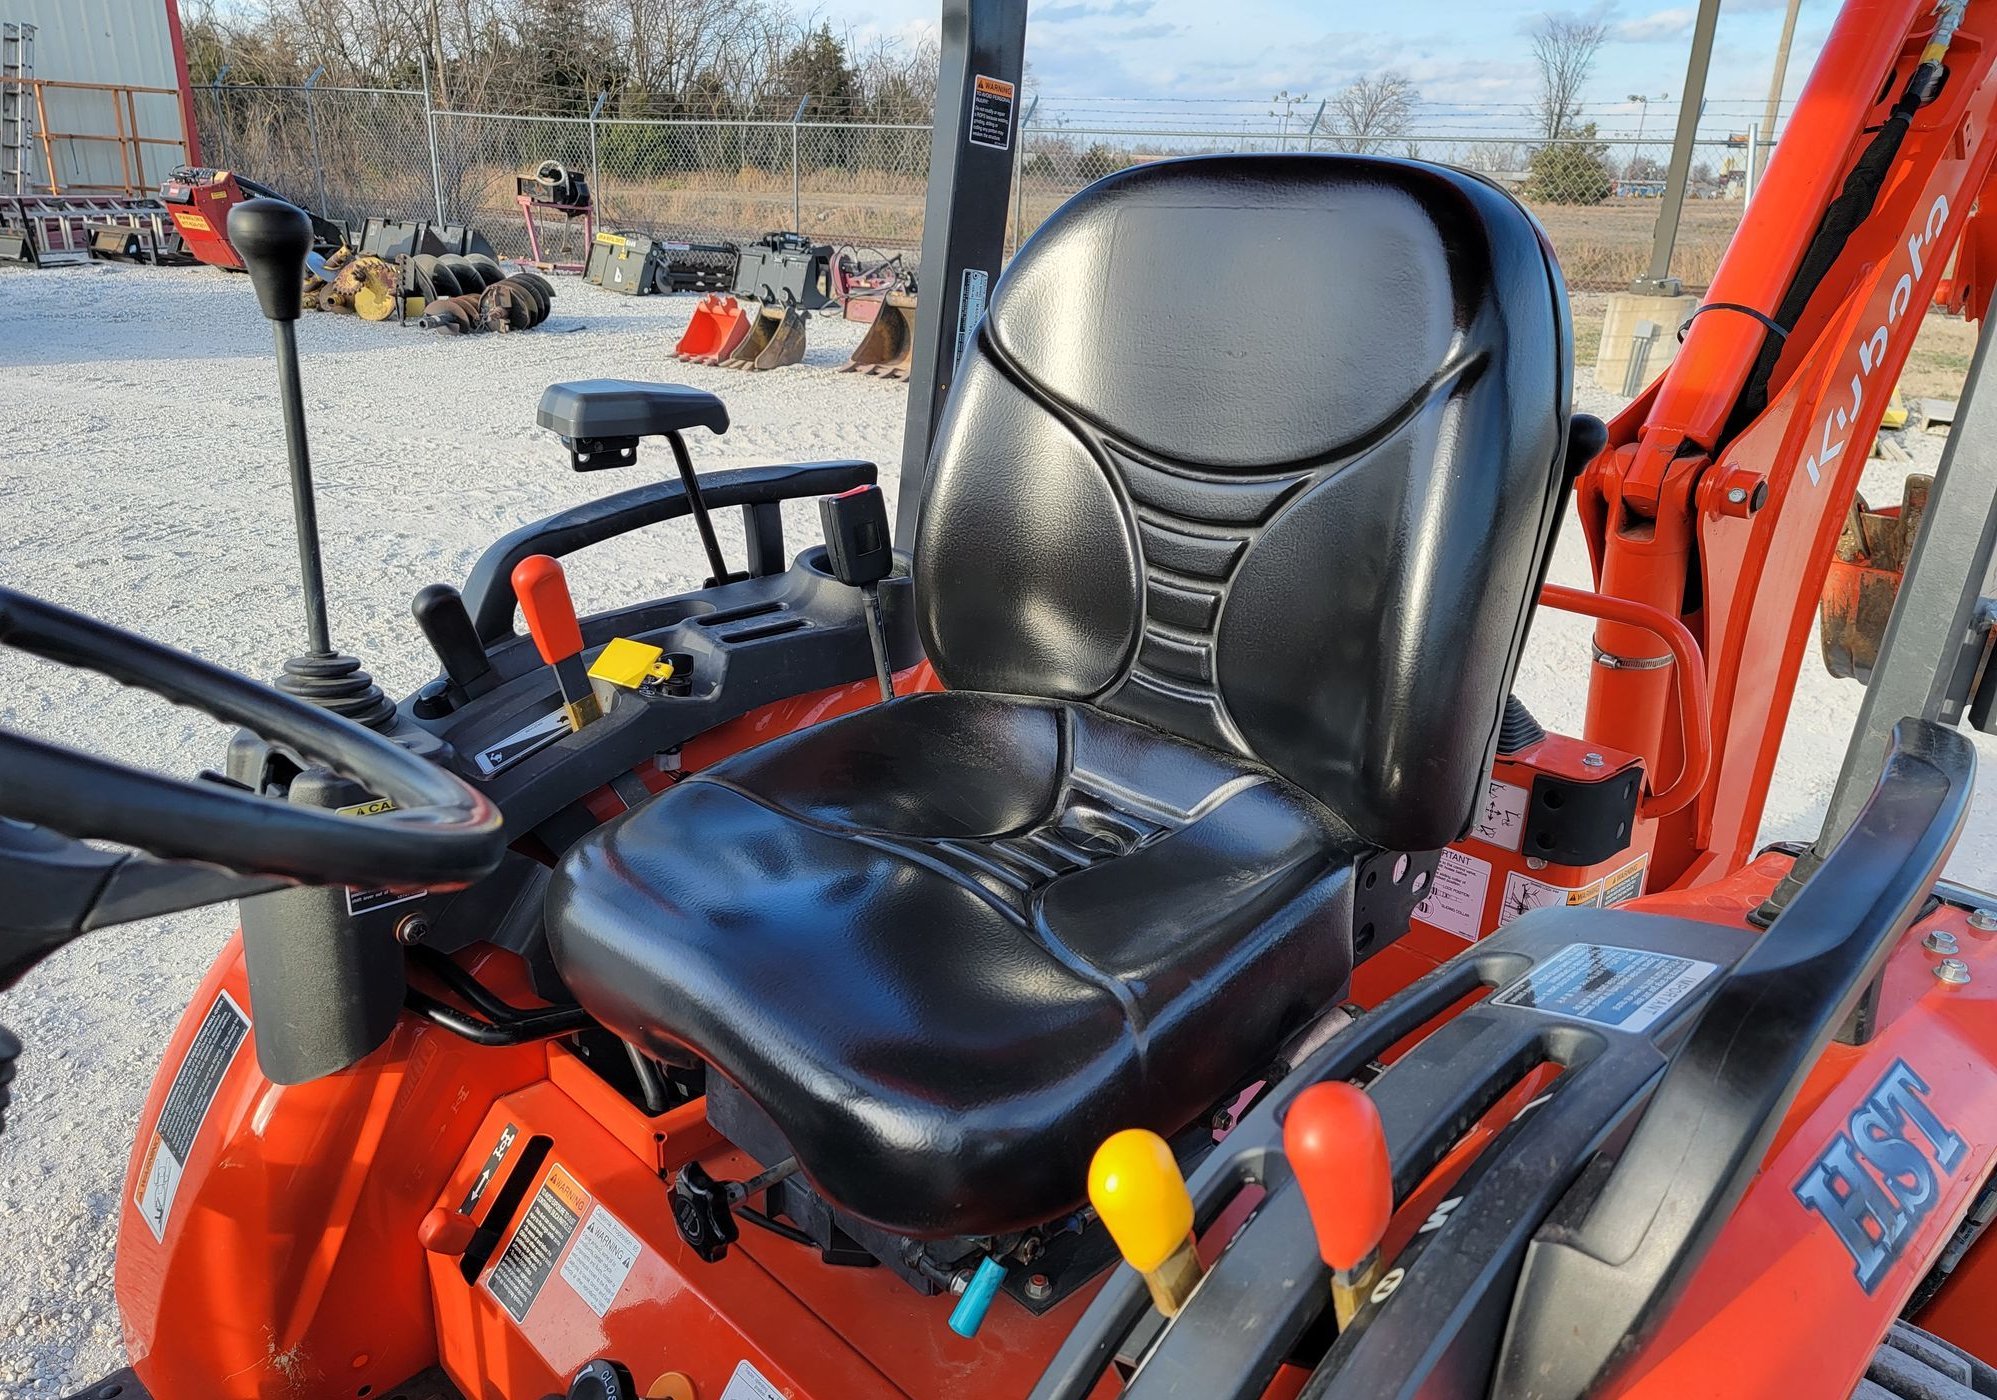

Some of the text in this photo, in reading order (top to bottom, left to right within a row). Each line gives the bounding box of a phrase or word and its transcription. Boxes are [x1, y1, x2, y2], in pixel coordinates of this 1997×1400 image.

[985, 81, 1011, 95] WARNING
[1806, 194, 1949, 487] Kubota
[1617, 864, 1638, 881] WARNING
[1648, 975, 1697, 1015] IMPORTANT
[141, 1136, 161, 1188] WARNING
[1792, 1056, 1972, 1296] HST
[554, 1177, 585, 1211] WARNING
[593, 1225, 625, 1261] WARNING
